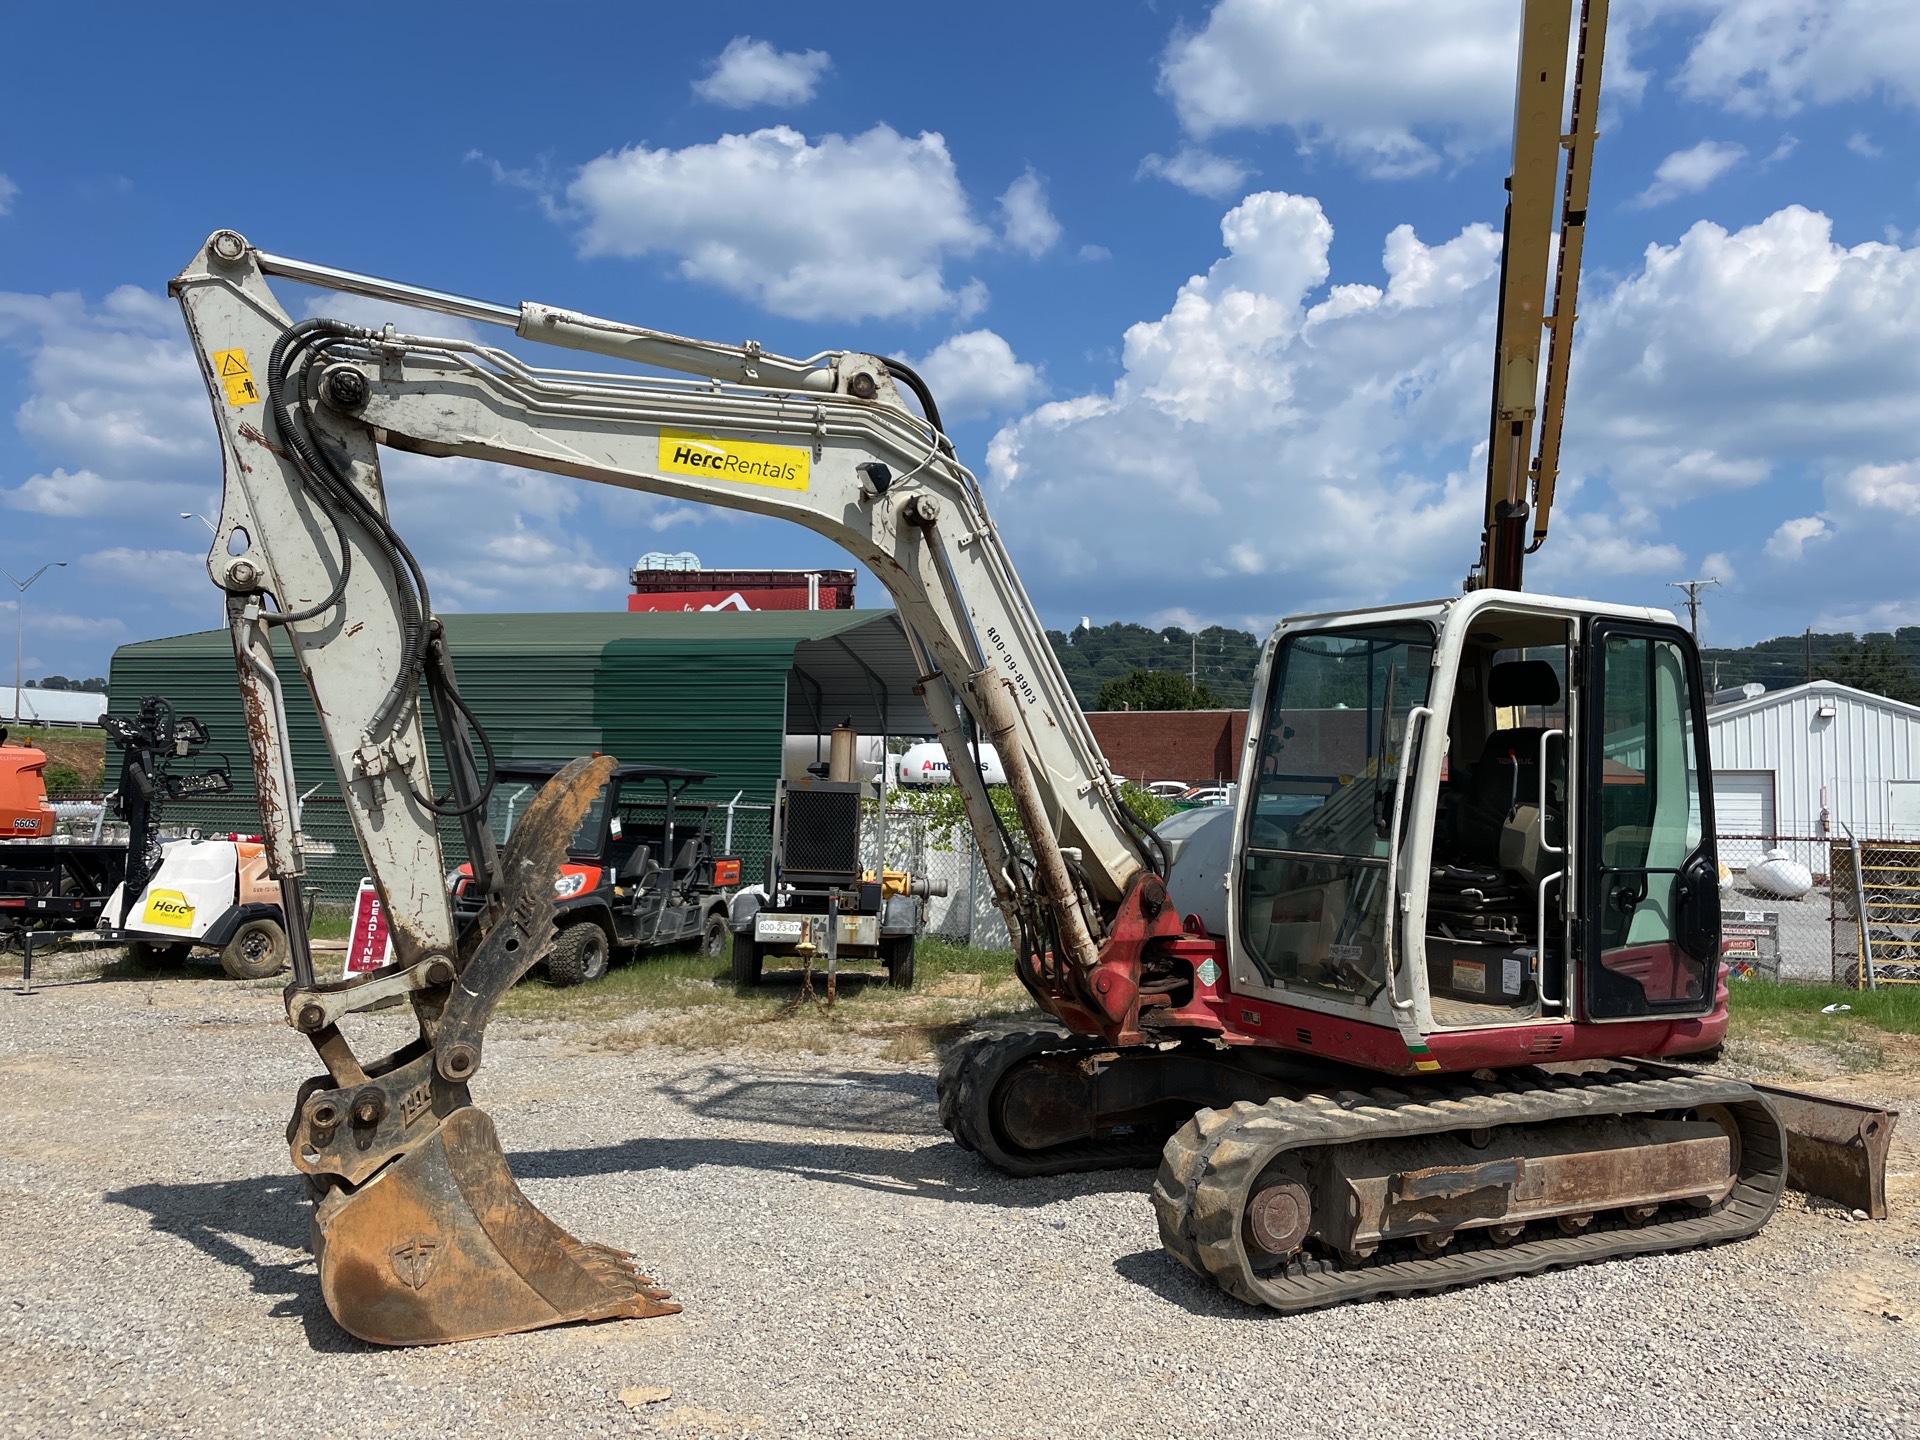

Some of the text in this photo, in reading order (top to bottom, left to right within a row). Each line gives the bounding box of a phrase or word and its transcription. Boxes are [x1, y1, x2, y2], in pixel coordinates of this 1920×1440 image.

[987, 627, 1036, 704] 800-09-8903
[153, 900, 189, 915] Herc
[160, 912, 184, 920] Rentals
[362, 899, 380, 964] DEADLINE
